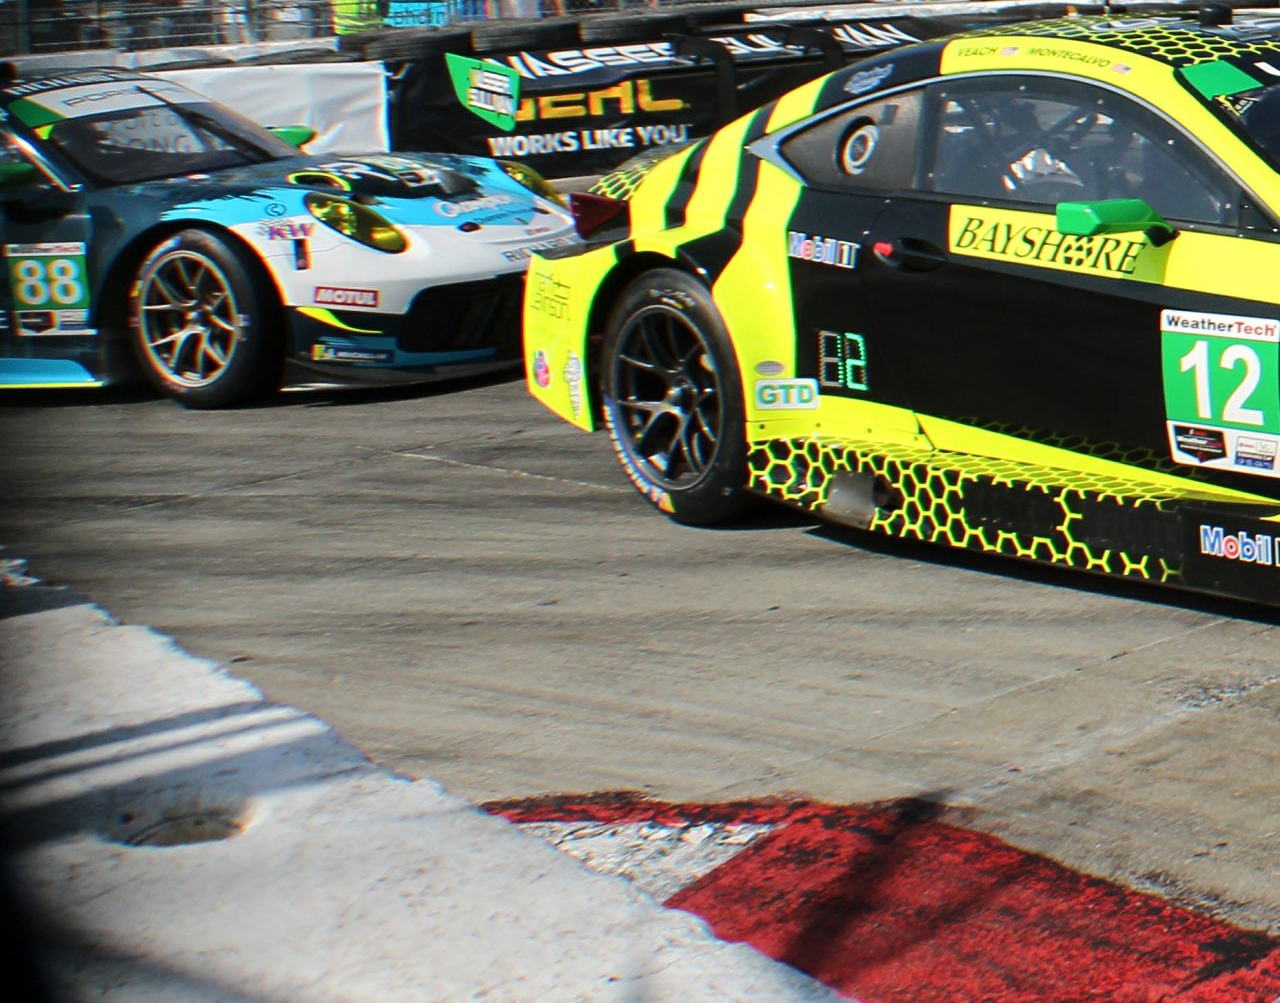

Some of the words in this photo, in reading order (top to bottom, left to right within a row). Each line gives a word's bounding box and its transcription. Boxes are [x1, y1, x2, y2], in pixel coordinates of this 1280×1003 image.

[957, 46, 999, 57] VEACH
[1027, 47, 1111, 68] MONTECALVO
[515, 79, 684, 122] EHL
[488, 132, 579, 157] WORKS
[582, 128, 635, 150] LIKE
[635, 124, 689, 145] YOU
[788, 231, 838, 266] Mobil
[13, 259, 84, 306] 88
[317, 288, 377, 306] MOTUL
[1166, 314, 1275, 337] WeatherTech
[756, 384, 814, 405] GTD
[1180, 340, 1264, 426] 12
[1200, 524, 1272, 566] Mobil
